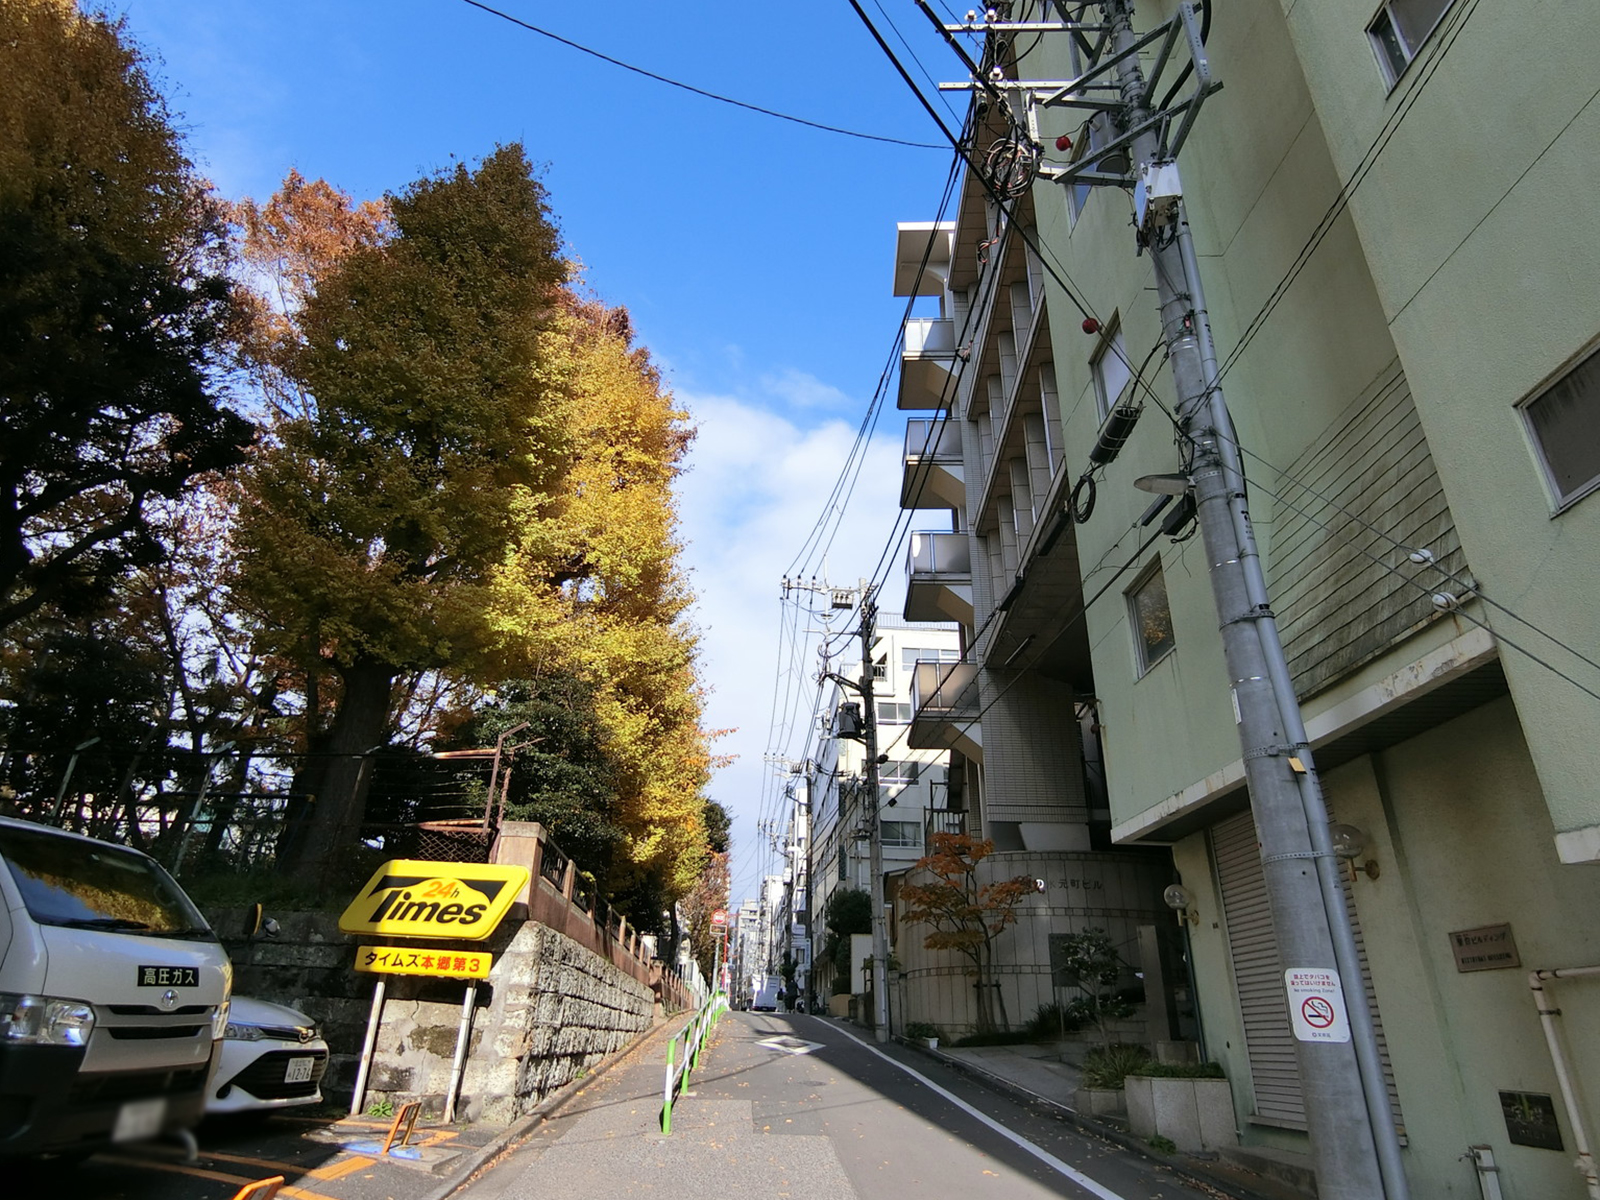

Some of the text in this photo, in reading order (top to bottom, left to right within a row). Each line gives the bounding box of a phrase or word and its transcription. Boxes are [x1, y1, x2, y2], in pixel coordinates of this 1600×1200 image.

[421, 881, 459, 898] 24h
[368, 889, 487, 924] Times
[364, 952, 480, 973] タイムズ本郷第3
[143, 967, 195, 985] 高圧ガス
